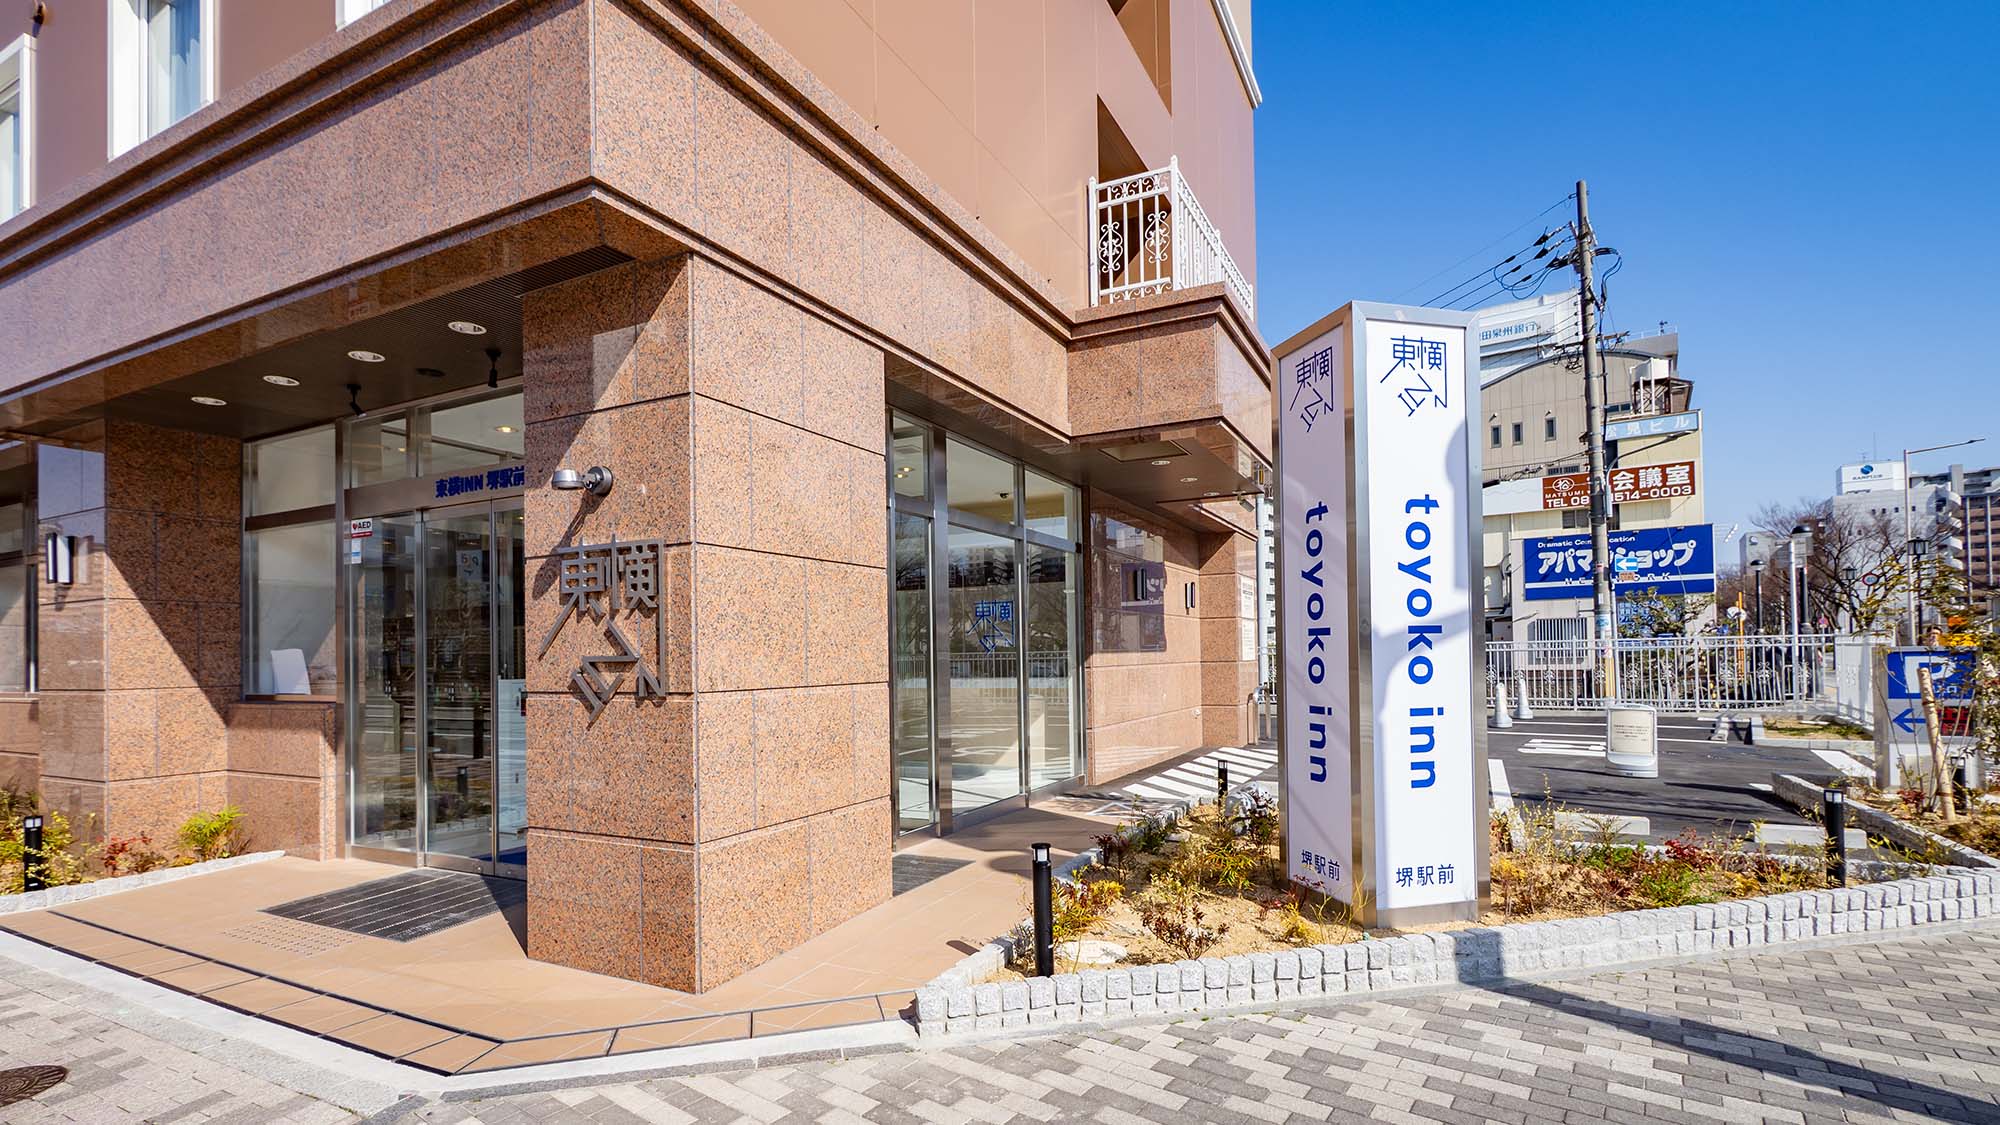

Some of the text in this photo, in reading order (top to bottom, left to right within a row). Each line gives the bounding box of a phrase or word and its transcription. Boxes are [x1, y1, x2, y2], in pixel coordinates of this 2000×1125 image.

[1480, 321, 1537, 340] 田泉州銀行
[1586, 465, 1690, 496] 会議室
[1545, 490, 1584, 498] MATSUMI
[1546, 498, 1568, 508] TEL
[358, 521, 371, 529] AED
[1538, 540, 1573, 549] Dramatic
[1301, 500, 1332, 783] toyoko inn
[1398, 494, 1444, 789] toyoko inn
[1301, 849, 1341, 881] 堺駅前
[1395, 864, 1455, 888] 堺駅前
